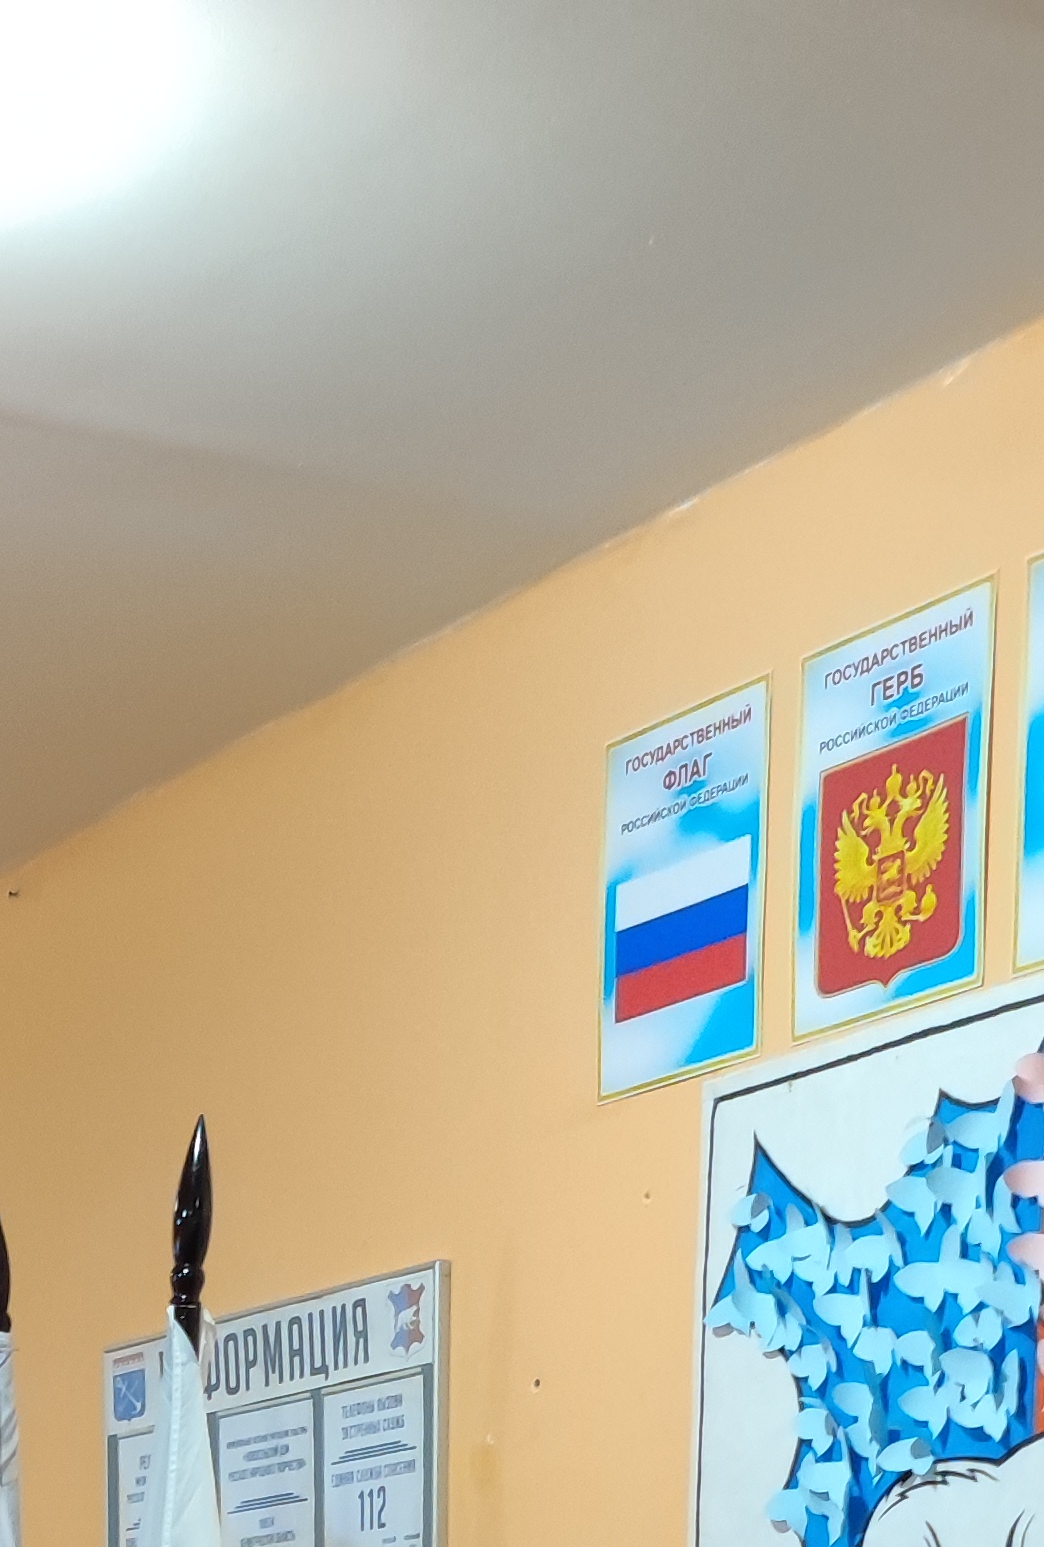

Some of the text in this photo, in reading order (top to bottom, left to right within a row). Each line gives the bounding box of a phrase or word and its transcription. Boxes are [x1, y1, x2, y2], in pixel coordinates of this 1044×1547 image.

[824, 607, 974, 690] ГОСУДАРСТВЕННЫЙ
[819, 682, 969, 754] РОССИЙСКОЙ ФЕДЕРАЦИИ
[870, 663, 924, 707] ГЕРБ
[625, 703, 752, 776] ГОСУДАРСТВЕННЫЙ
[662, 751, 713, 790] ФЛАГ
[158, 1297, 371, 1402] ФОРМАЦИЯ
[358, 1485, 386, 1532] 112
